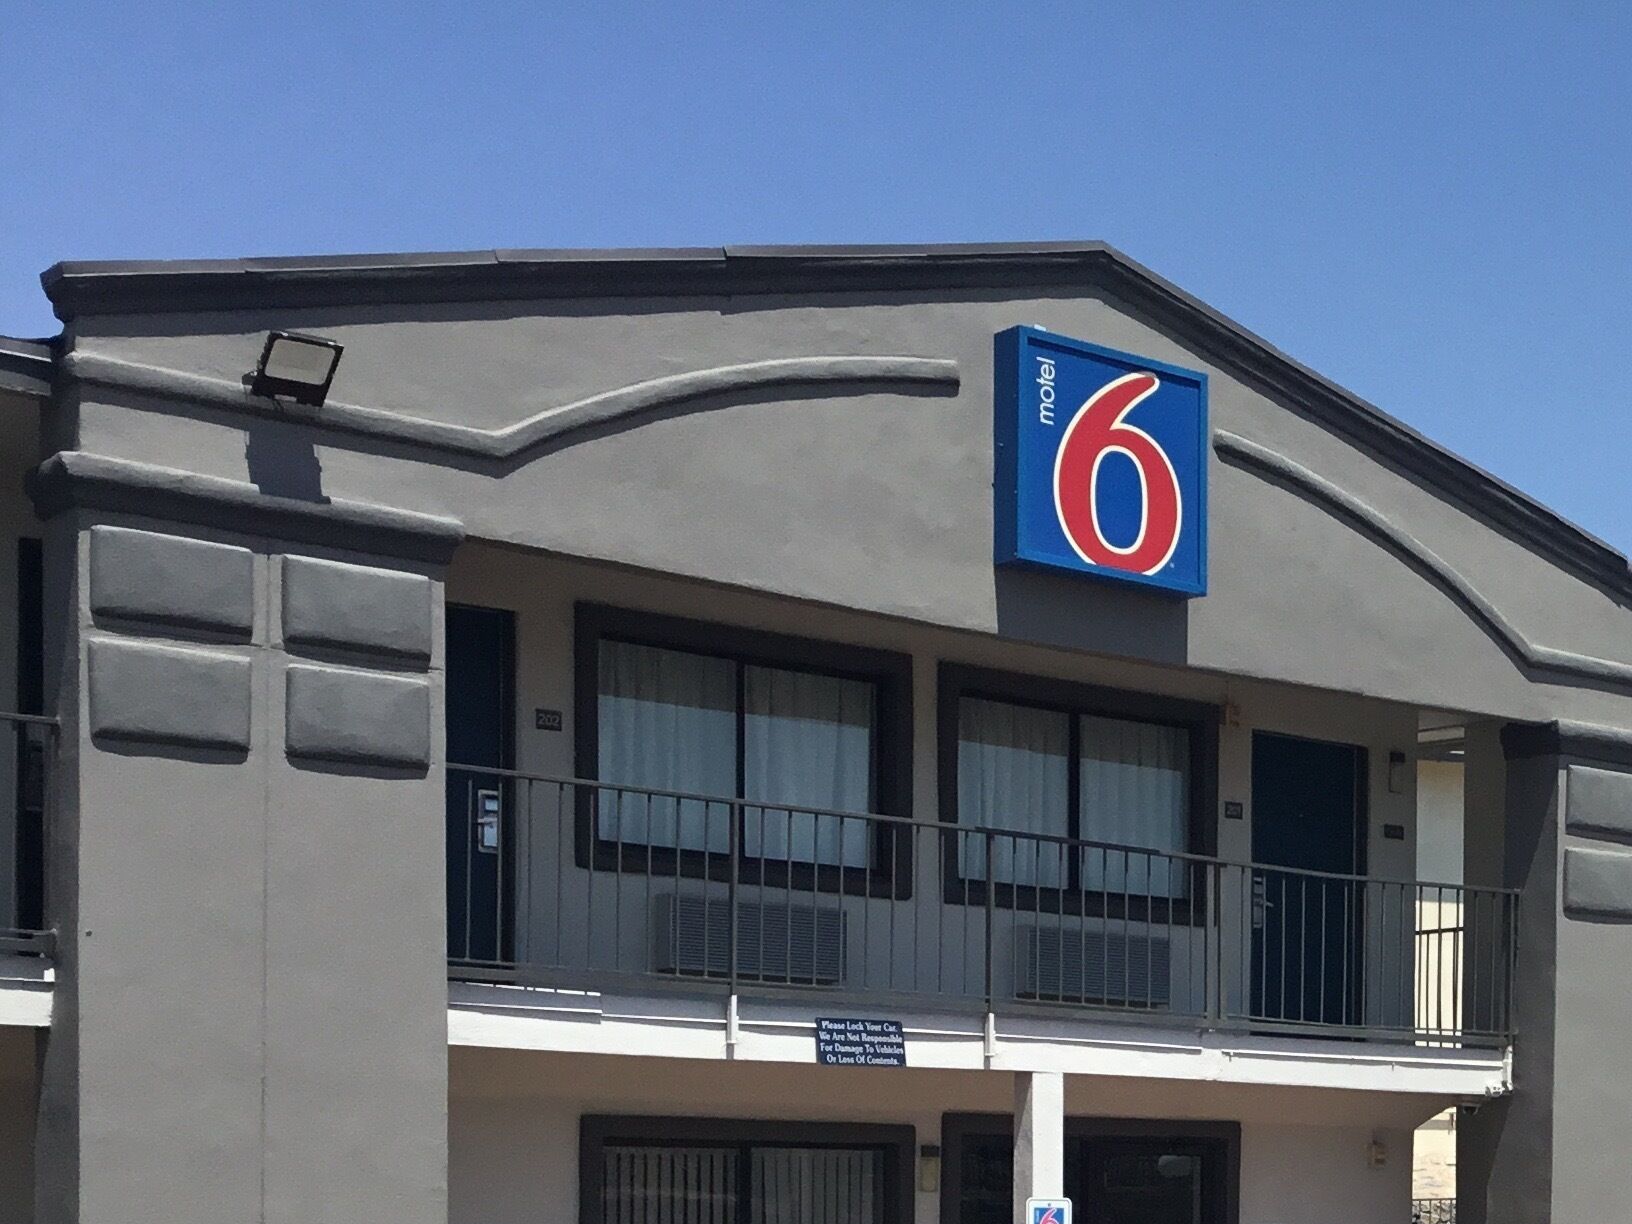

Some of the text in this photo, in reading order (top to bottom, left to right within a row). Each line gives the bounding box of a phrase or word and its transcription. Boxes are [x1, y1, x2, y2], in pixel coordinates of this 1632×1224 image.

[1036, 356, 1182, 576] motel 6
[821, 1020, 845, 1030] Please
[846, 1021, 864, 1031] Lock
[864, 1022, 882, 1032] Your
[818, 1031, 903, 1044] We Are Not Responsible
[820, 1042, 904, 1055] For Damage To Vehicles
[826, 1054, 837, 1063] Or
[838, 1054, 855, 1064] Loss
[855, 1054, 866, 1064] Of
